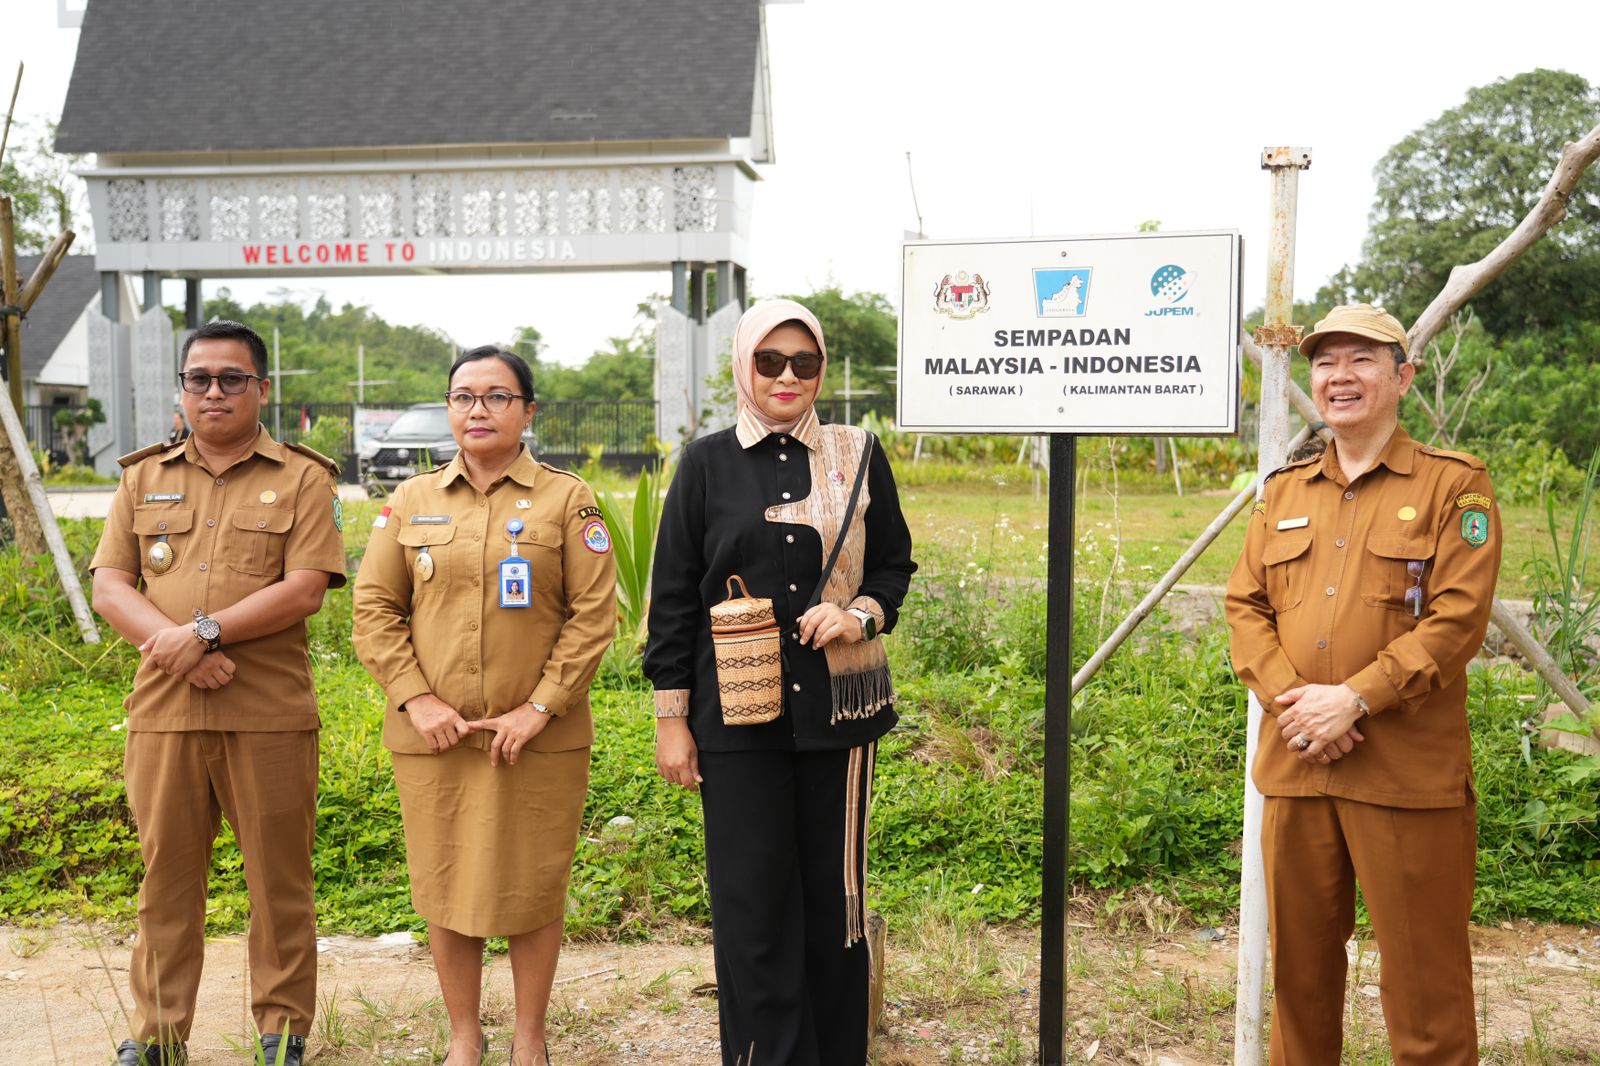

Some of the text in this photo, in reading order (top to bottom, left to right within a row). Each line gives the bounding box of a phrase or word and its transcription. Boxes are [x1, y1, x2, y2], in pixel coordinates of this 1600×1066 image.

[243, 240, 576, 264] WELCOME TO INDONESIA
[1144, 306, 1194, 317] JUPEM
[994, 328, 1131, 347] SEMPADAN
[924, 357, 1044, 375] MALAYSIA
[1063, 355, 1202, 374] INDONESIA
